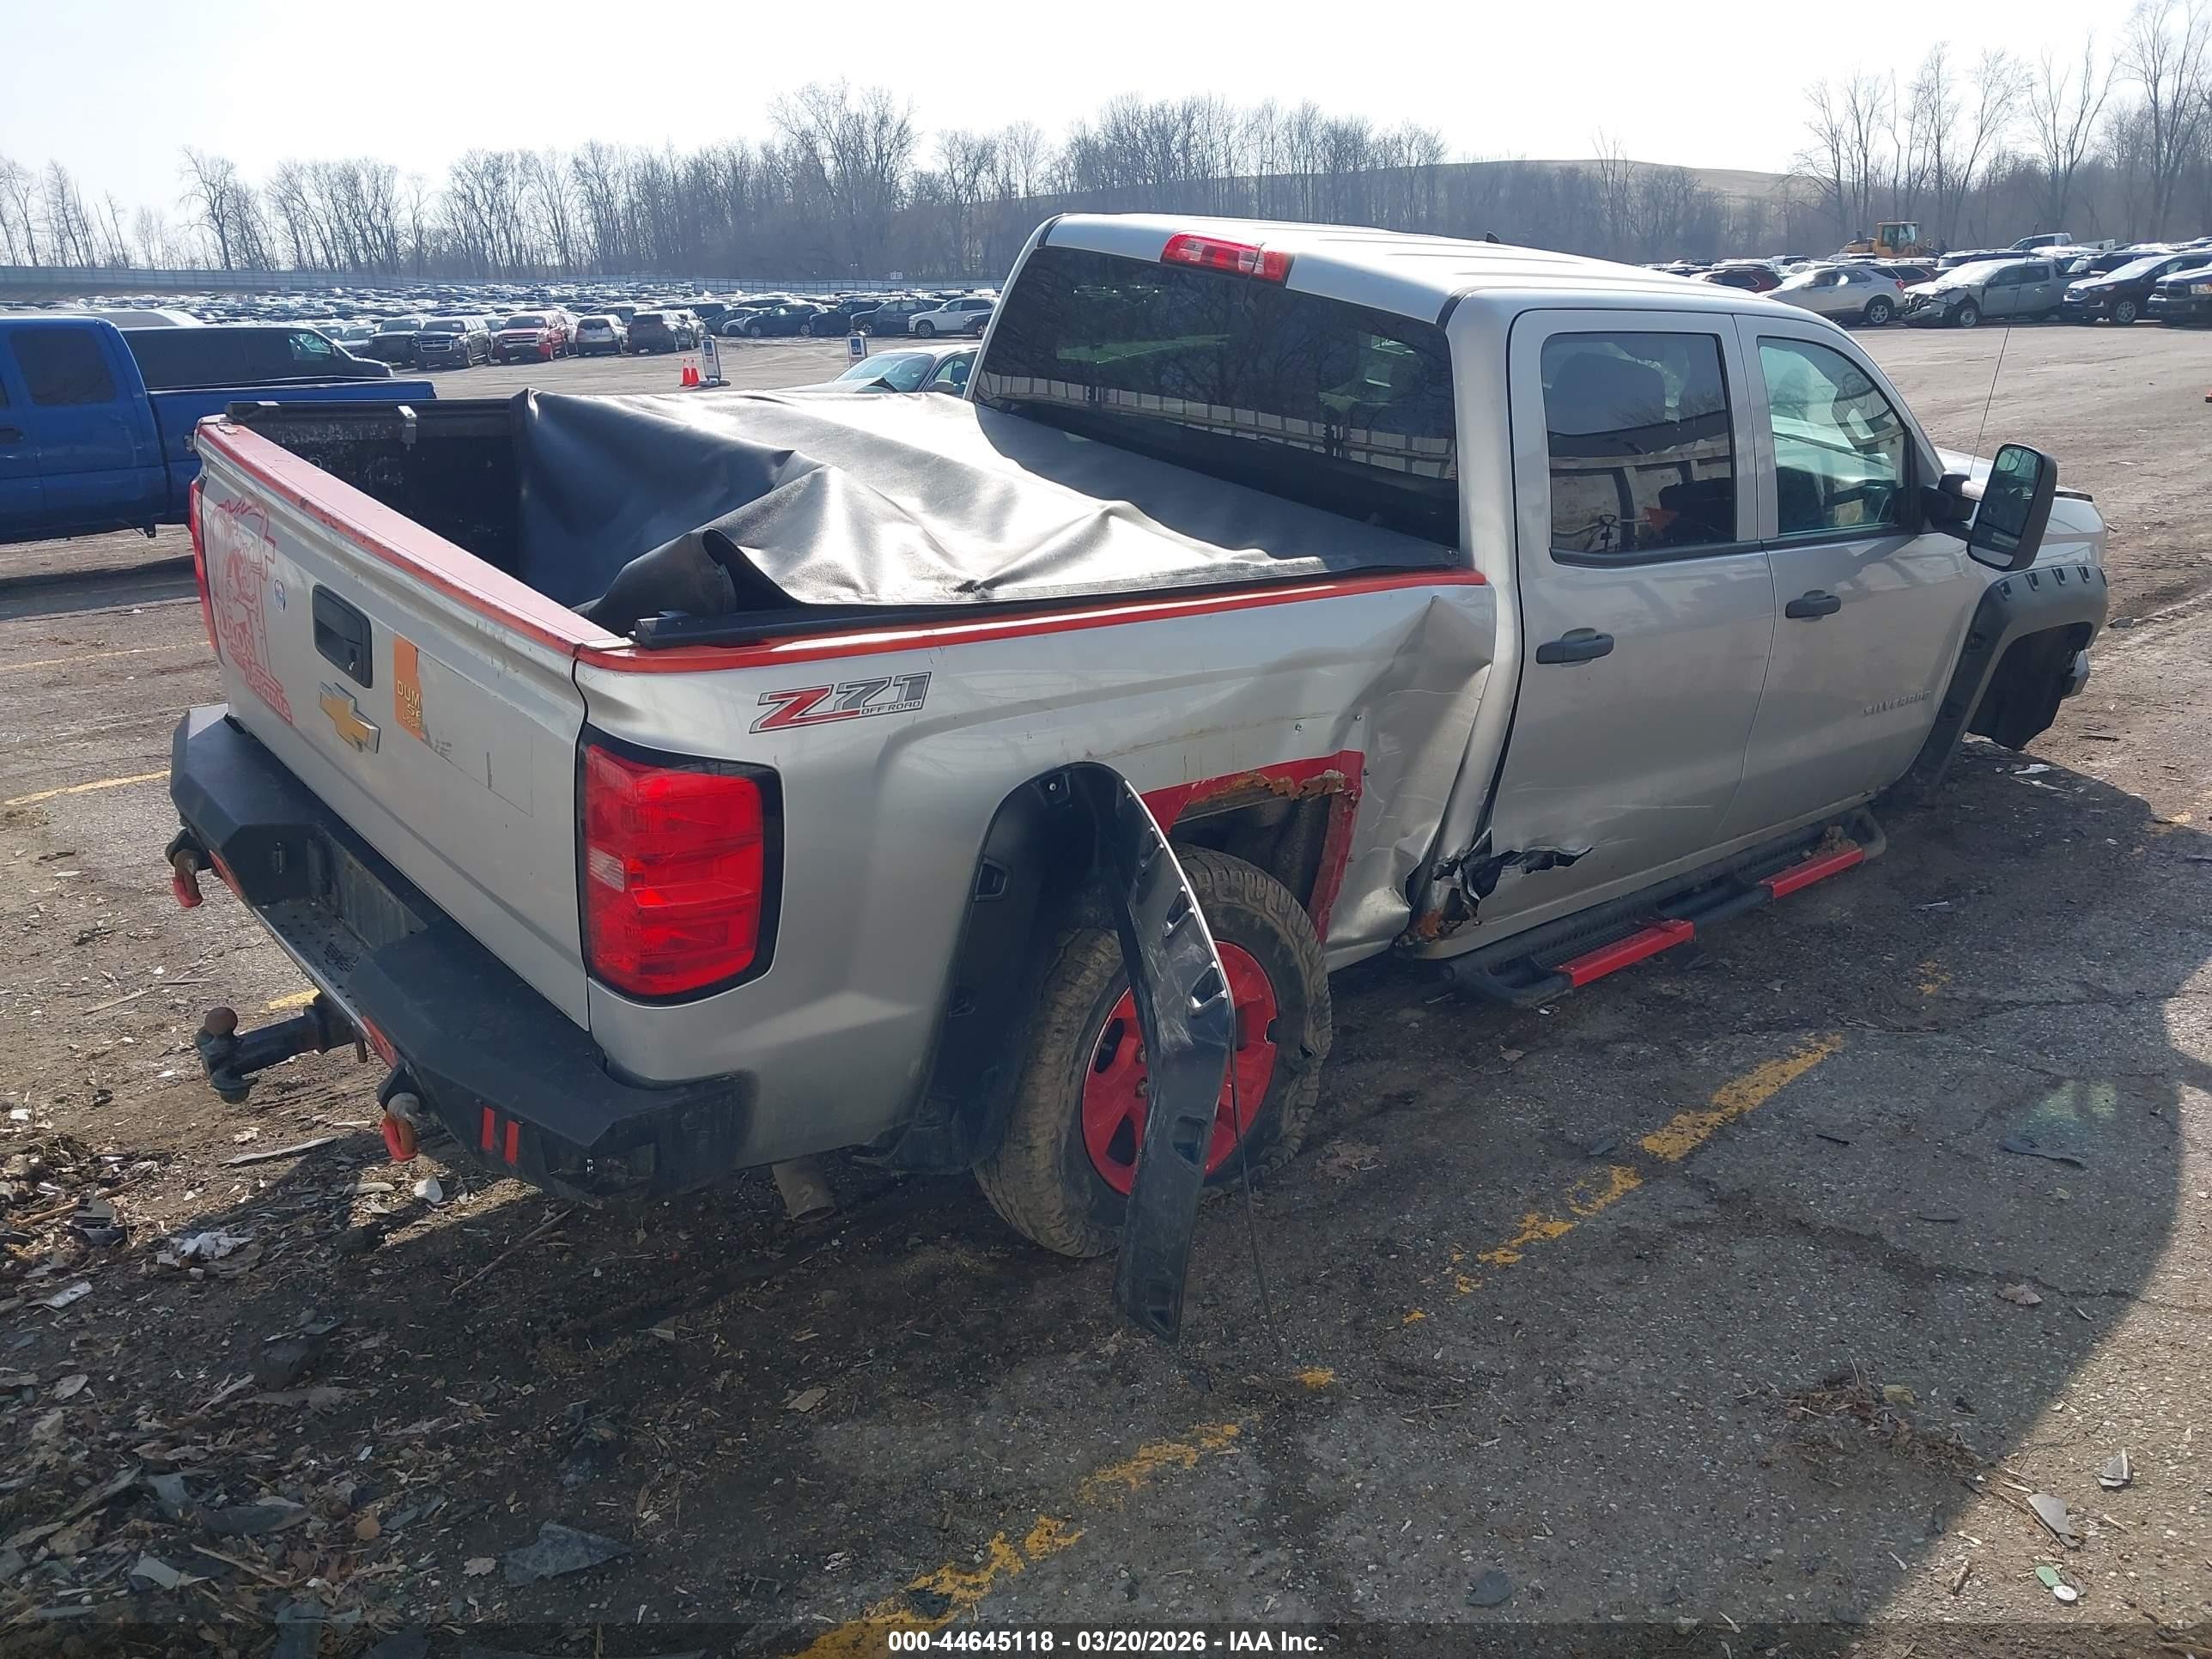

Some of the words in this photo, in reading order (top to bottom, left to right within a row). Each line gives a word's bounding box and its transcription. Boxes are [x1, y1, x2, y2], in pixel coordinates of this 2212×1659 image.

[397, 679, 422, 709] DUM
[749, 672, 932, 733] Z71
[861, 705, 887, 715] OFF
[888, 701, 921, 713] ROAD
